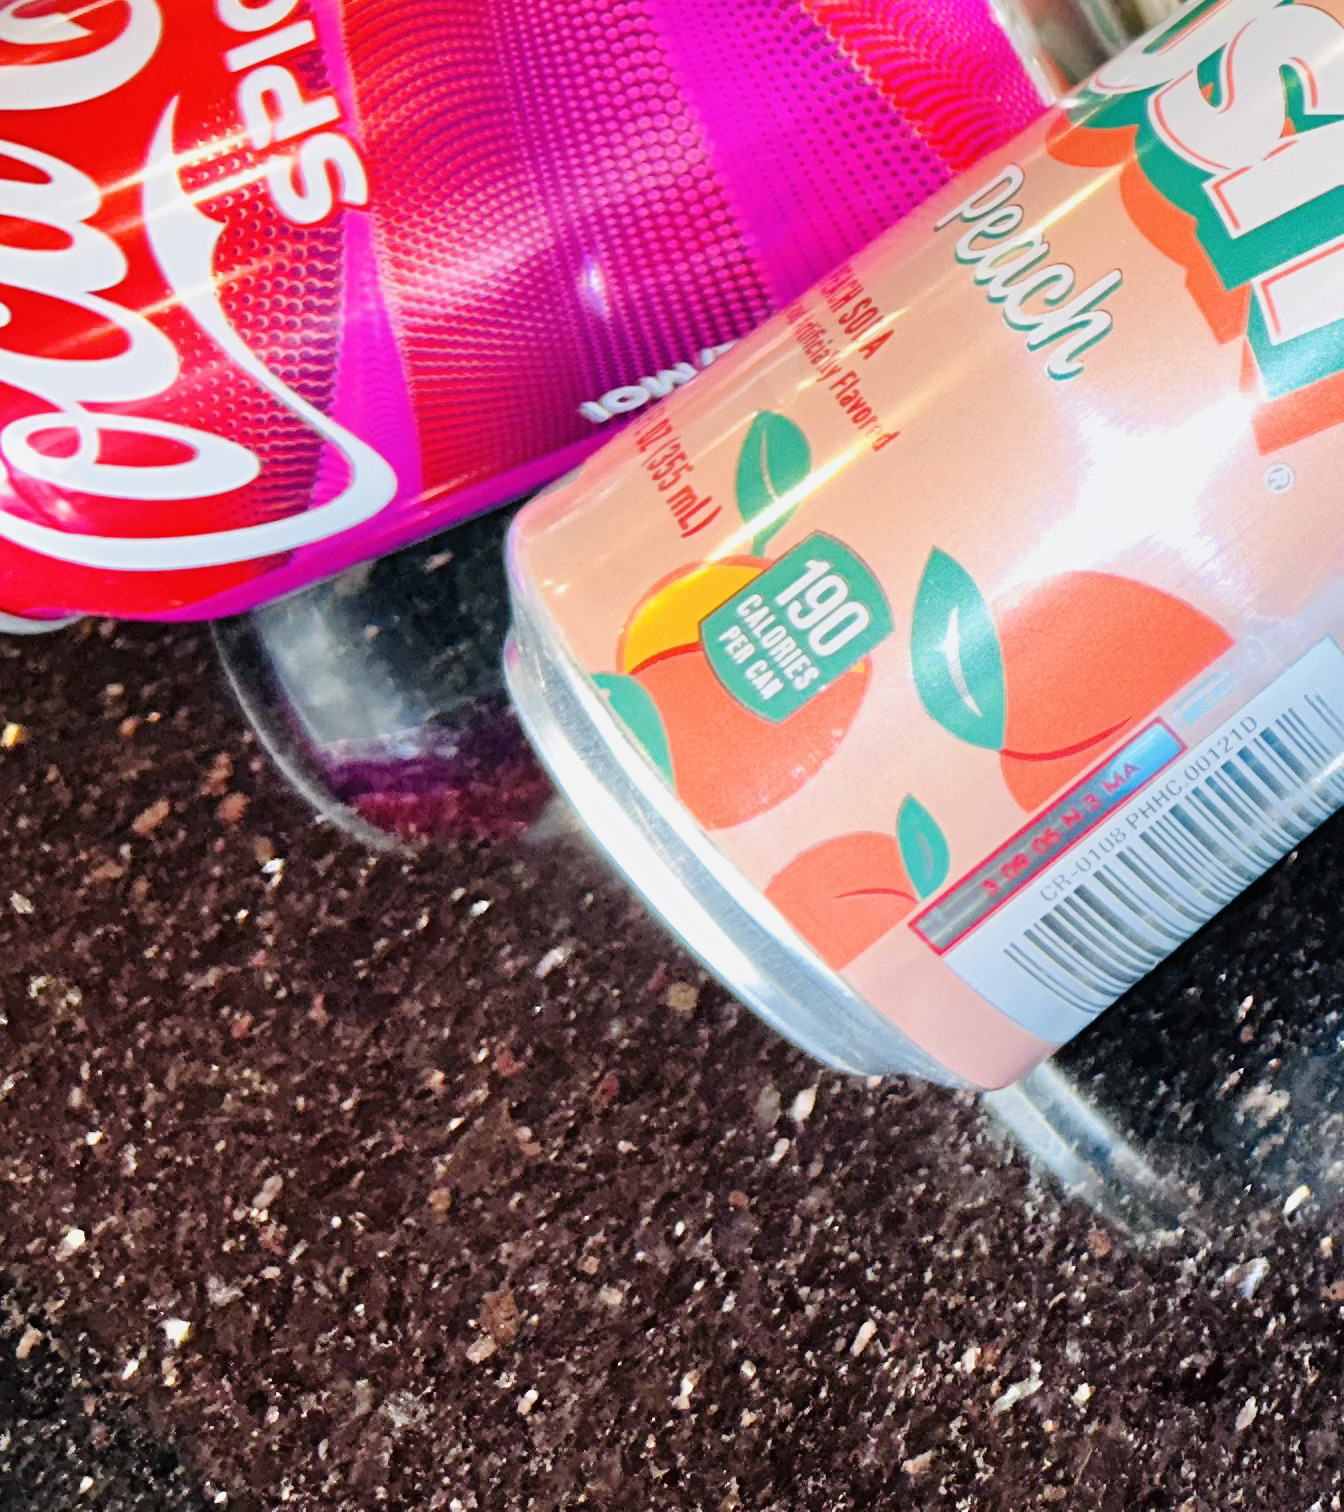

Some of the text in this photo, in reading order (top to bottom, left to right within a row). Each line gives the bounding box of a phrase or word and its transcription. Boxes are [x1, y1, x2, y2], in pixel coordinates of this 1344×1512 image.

[935, 164, 1123, 381] Peach
[641, 435, 695, 494] (355
[664, 483, 724, 540] mL)
[736, 593, 821, 692] CALORIES
[774, 559, 871, 657] 190
[717, 624, 785, 702] PER CAN
[1101, 762, 1141, 795] MA
[1039, 827, 1128, 903] CR-0108
